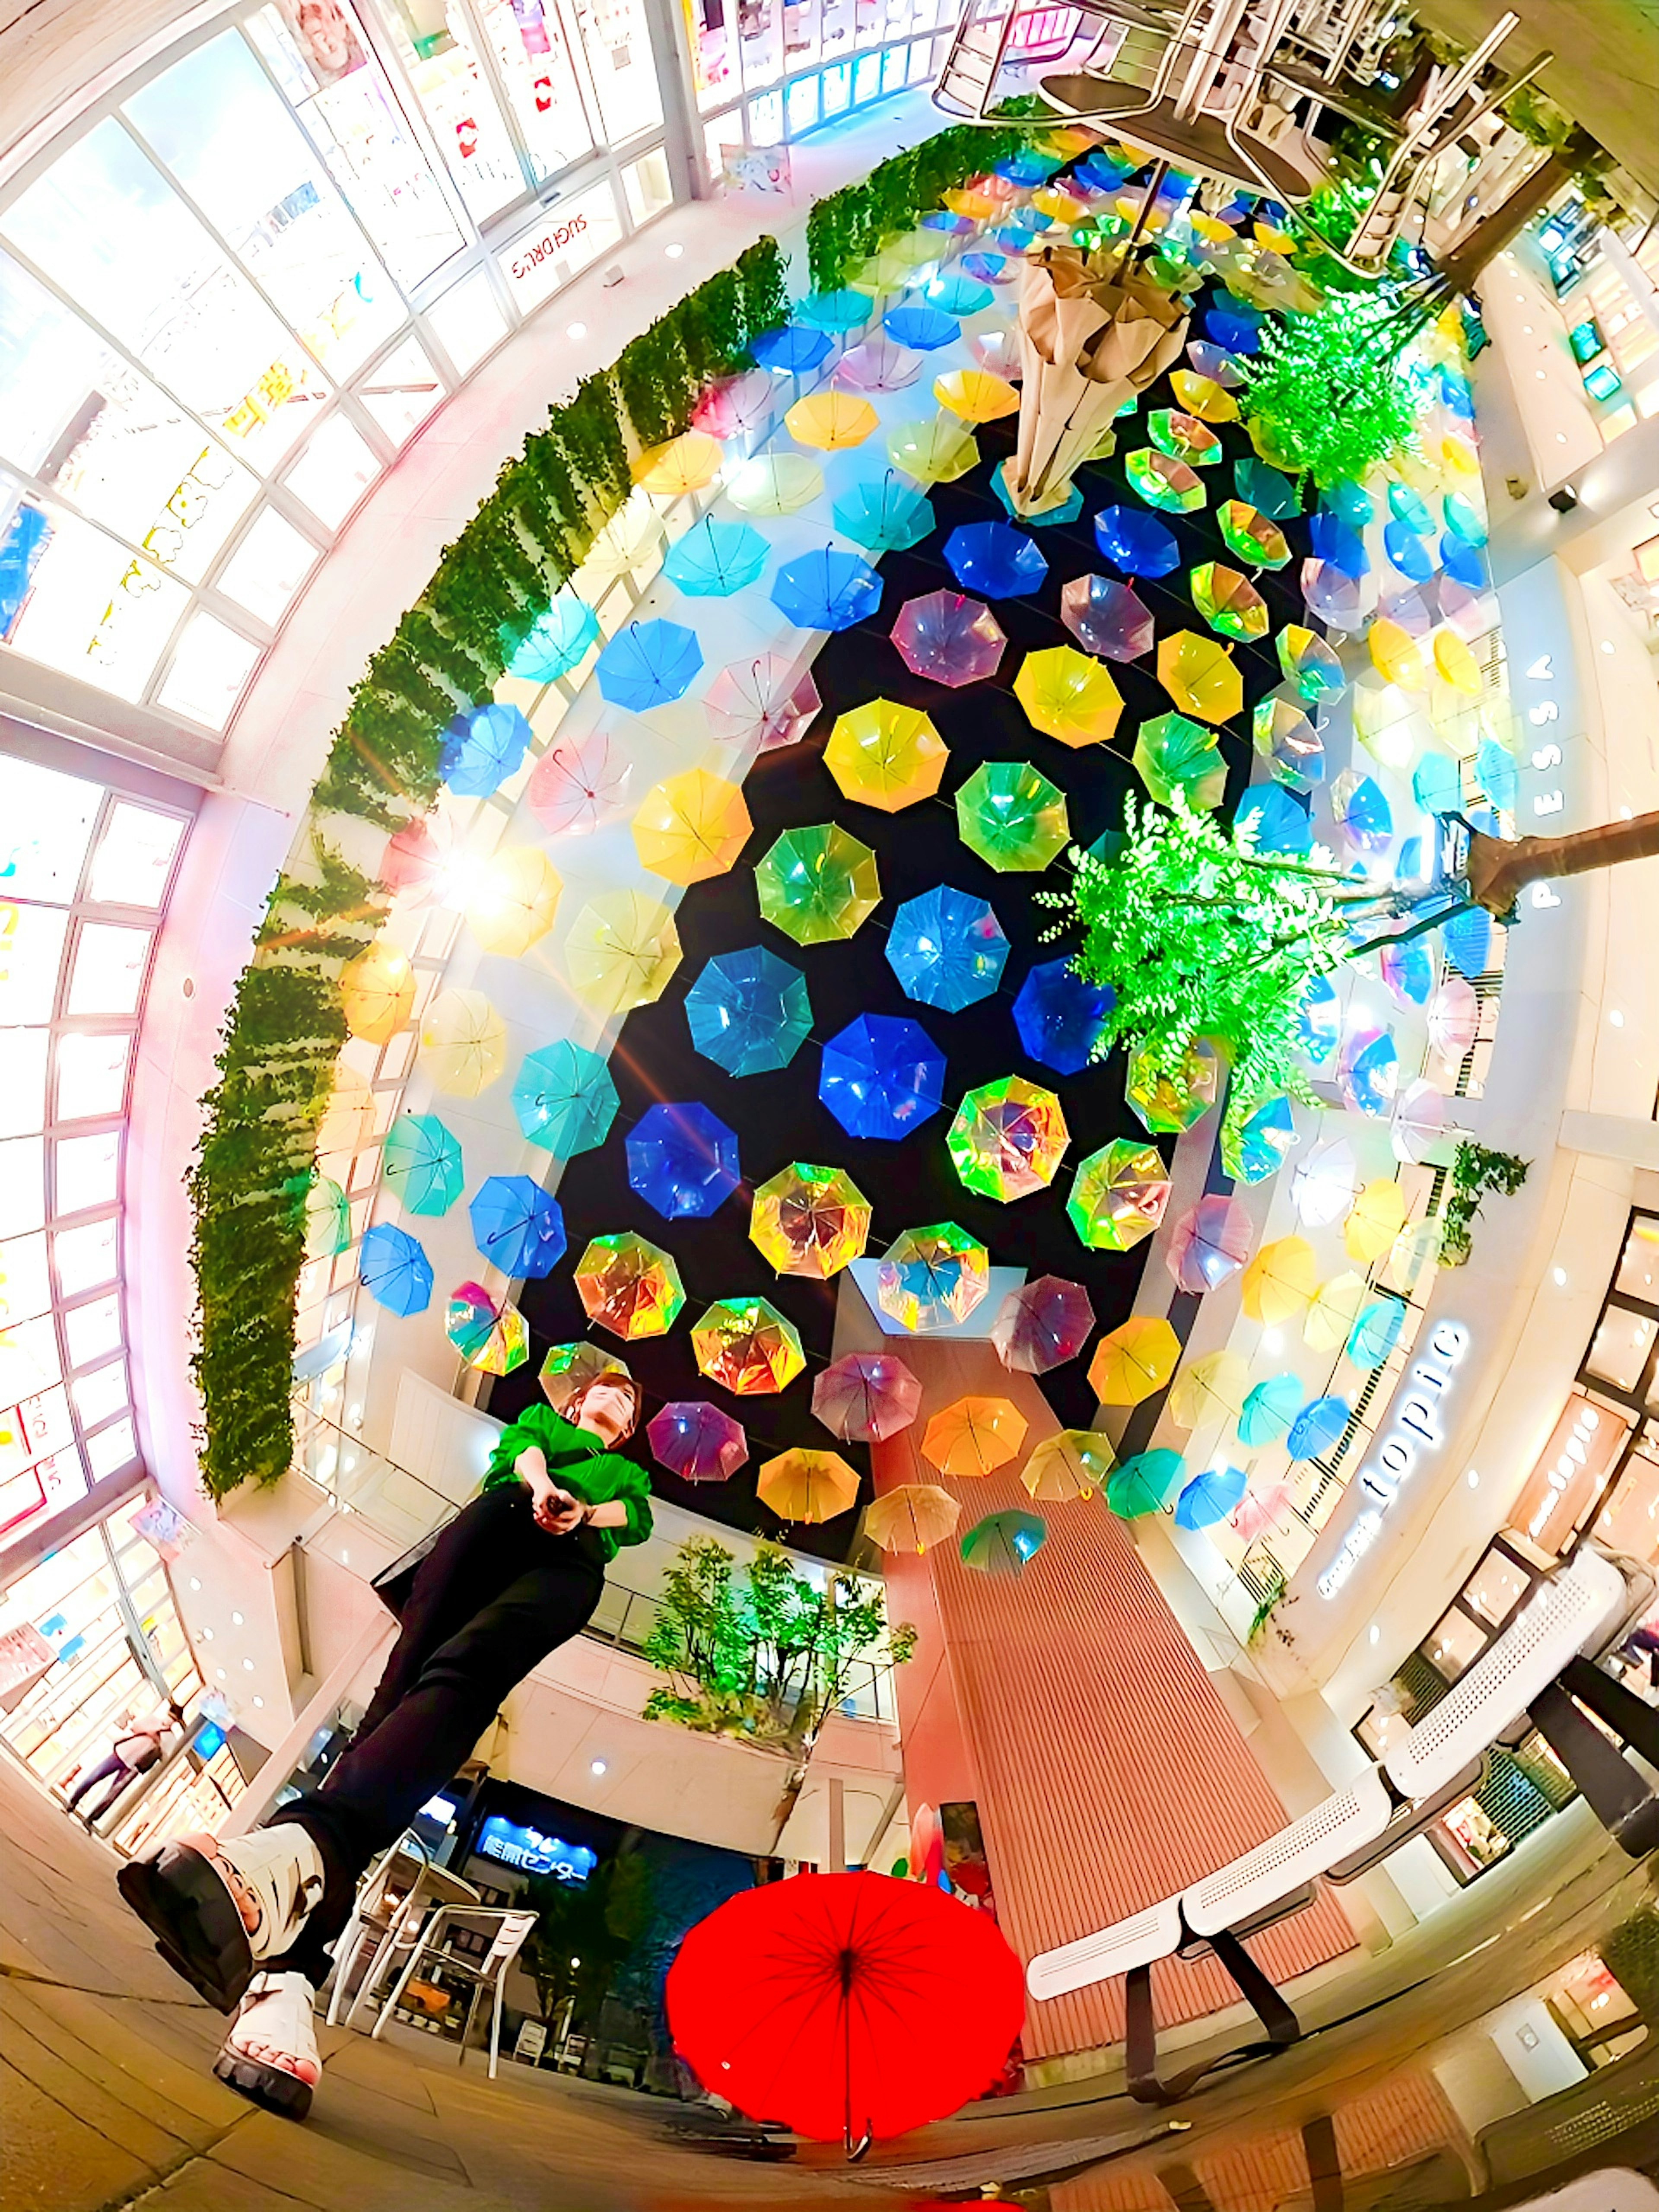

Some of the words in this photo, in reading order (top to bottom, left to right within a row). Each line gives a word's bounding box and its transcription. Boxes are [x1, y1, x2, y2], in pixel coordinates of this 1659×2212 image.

[553, 214, 587, 248] SUGI
[1528, 655, 1563, 908] PESSA
[1362, 1322, 1462, 1499] topic
